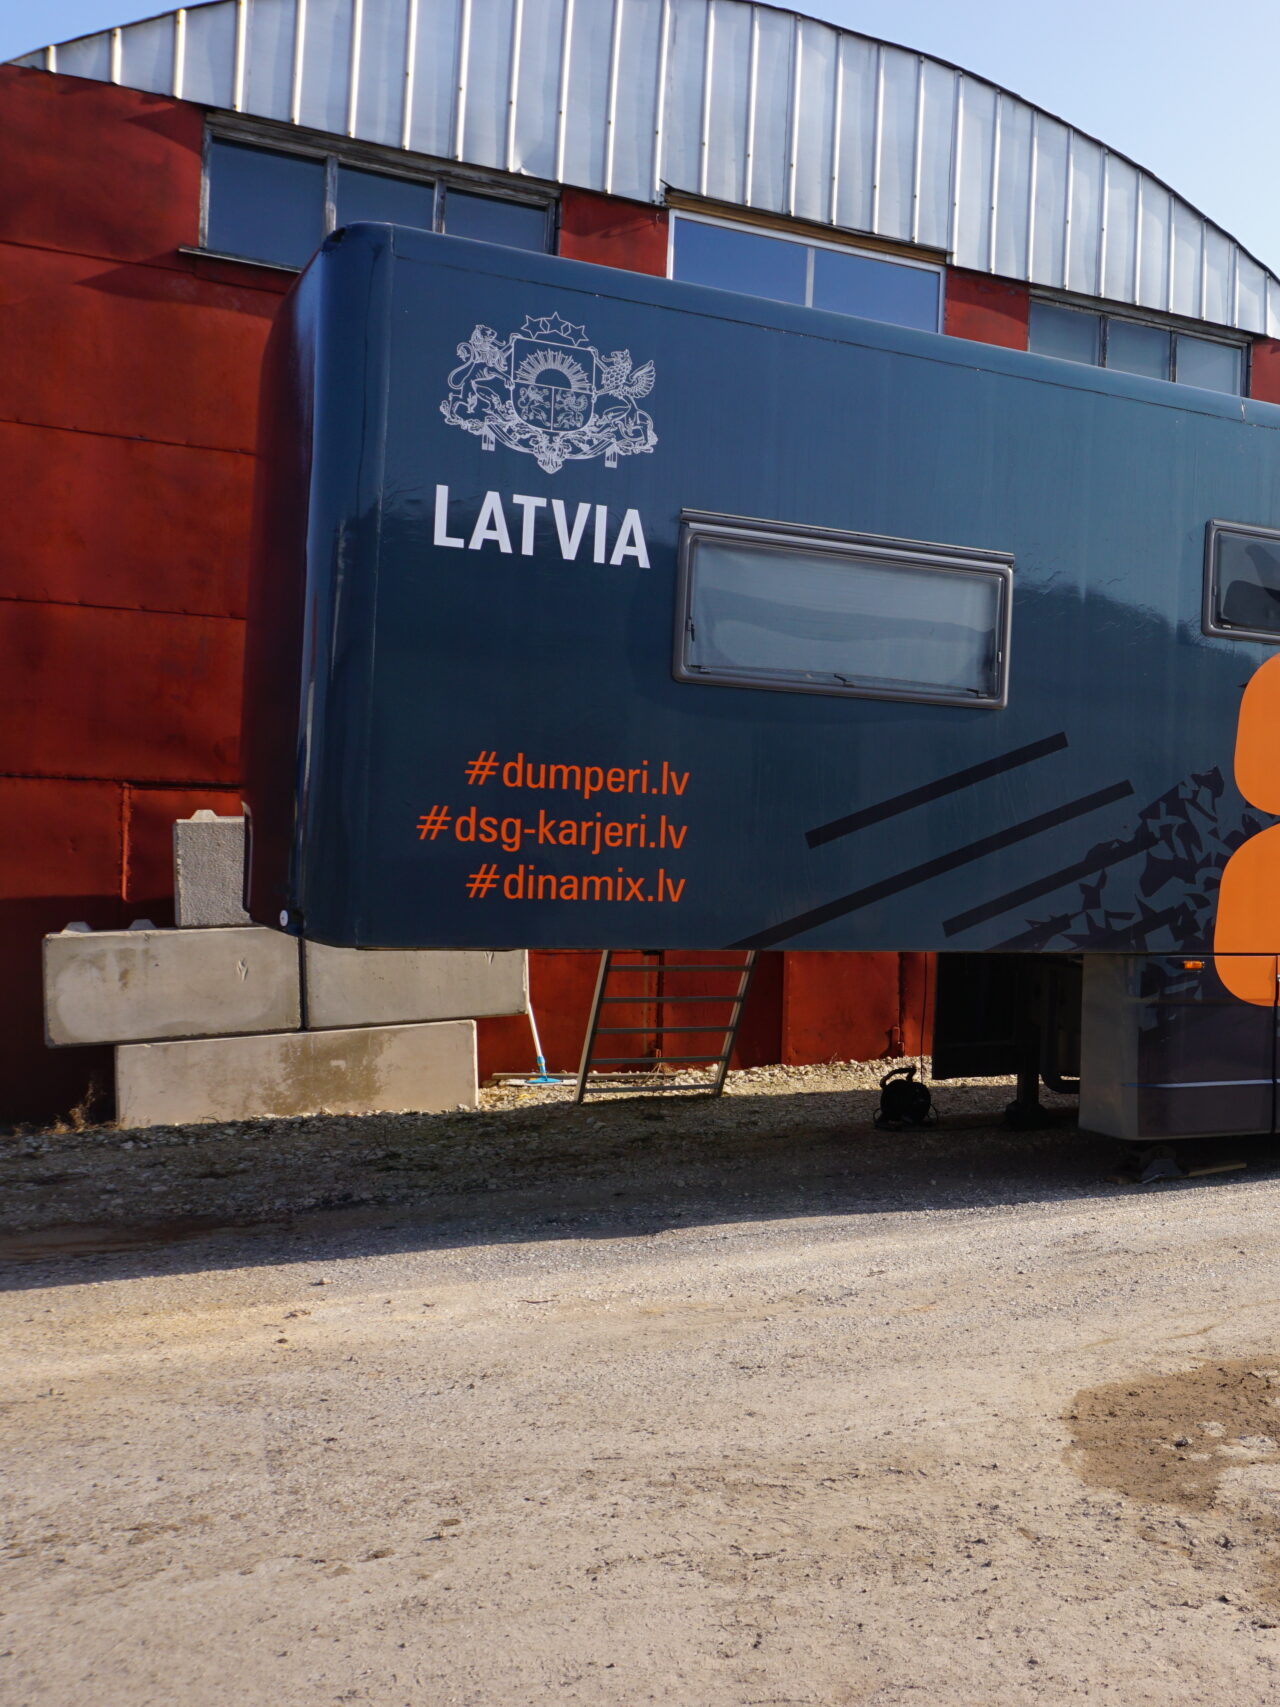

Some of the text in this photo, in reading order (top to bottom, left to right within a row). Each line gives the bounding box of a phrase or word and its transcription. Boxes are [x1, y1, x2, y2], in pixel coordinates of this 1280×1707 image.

[433, 484, 651, 569] LATVIA
[464, 750, 690, 799] #dumperi.lv
[416, 805, 689, 855] #dsg-karjeri.lv
[465, 863, 687, 903] #dinamix.lv
